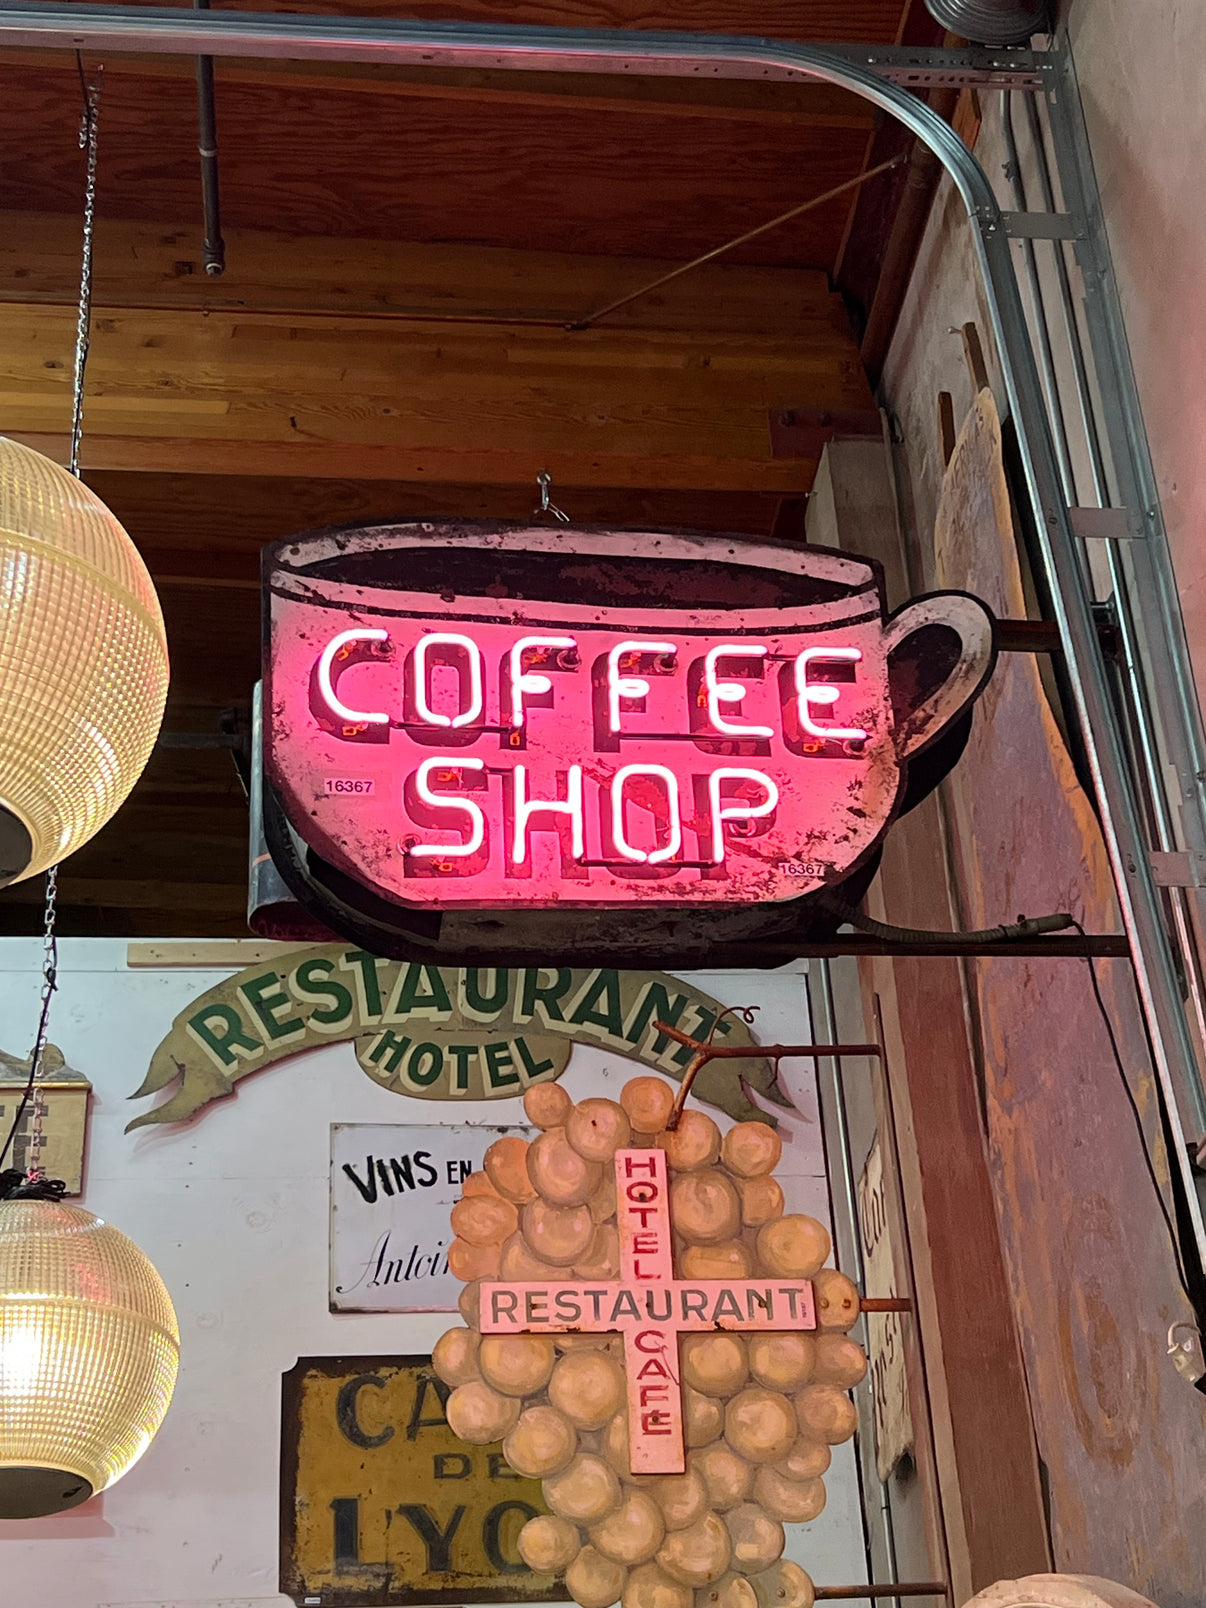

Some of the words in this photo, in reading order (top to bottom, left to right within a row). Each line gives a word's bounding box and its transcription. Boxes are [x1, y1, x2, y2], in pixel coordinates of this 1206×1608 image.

[310, 628, 868, 752] COFFEE
[326, 780, 373, 792] 16367
[403, 756, 779, 872] SHOP
[780, 863, 822, 875] 16367
[186, 950, 732, 1074] RESTAURANT
[361, 1029, 555, 1097] HOTEL
[341, 1151, 438, 1204] VINS
[446, 1160, 472, 1185] EN
[624, 1156, 662, 1280] HOTEL
[491, 1287, 804, 1324] RESTAURANT
